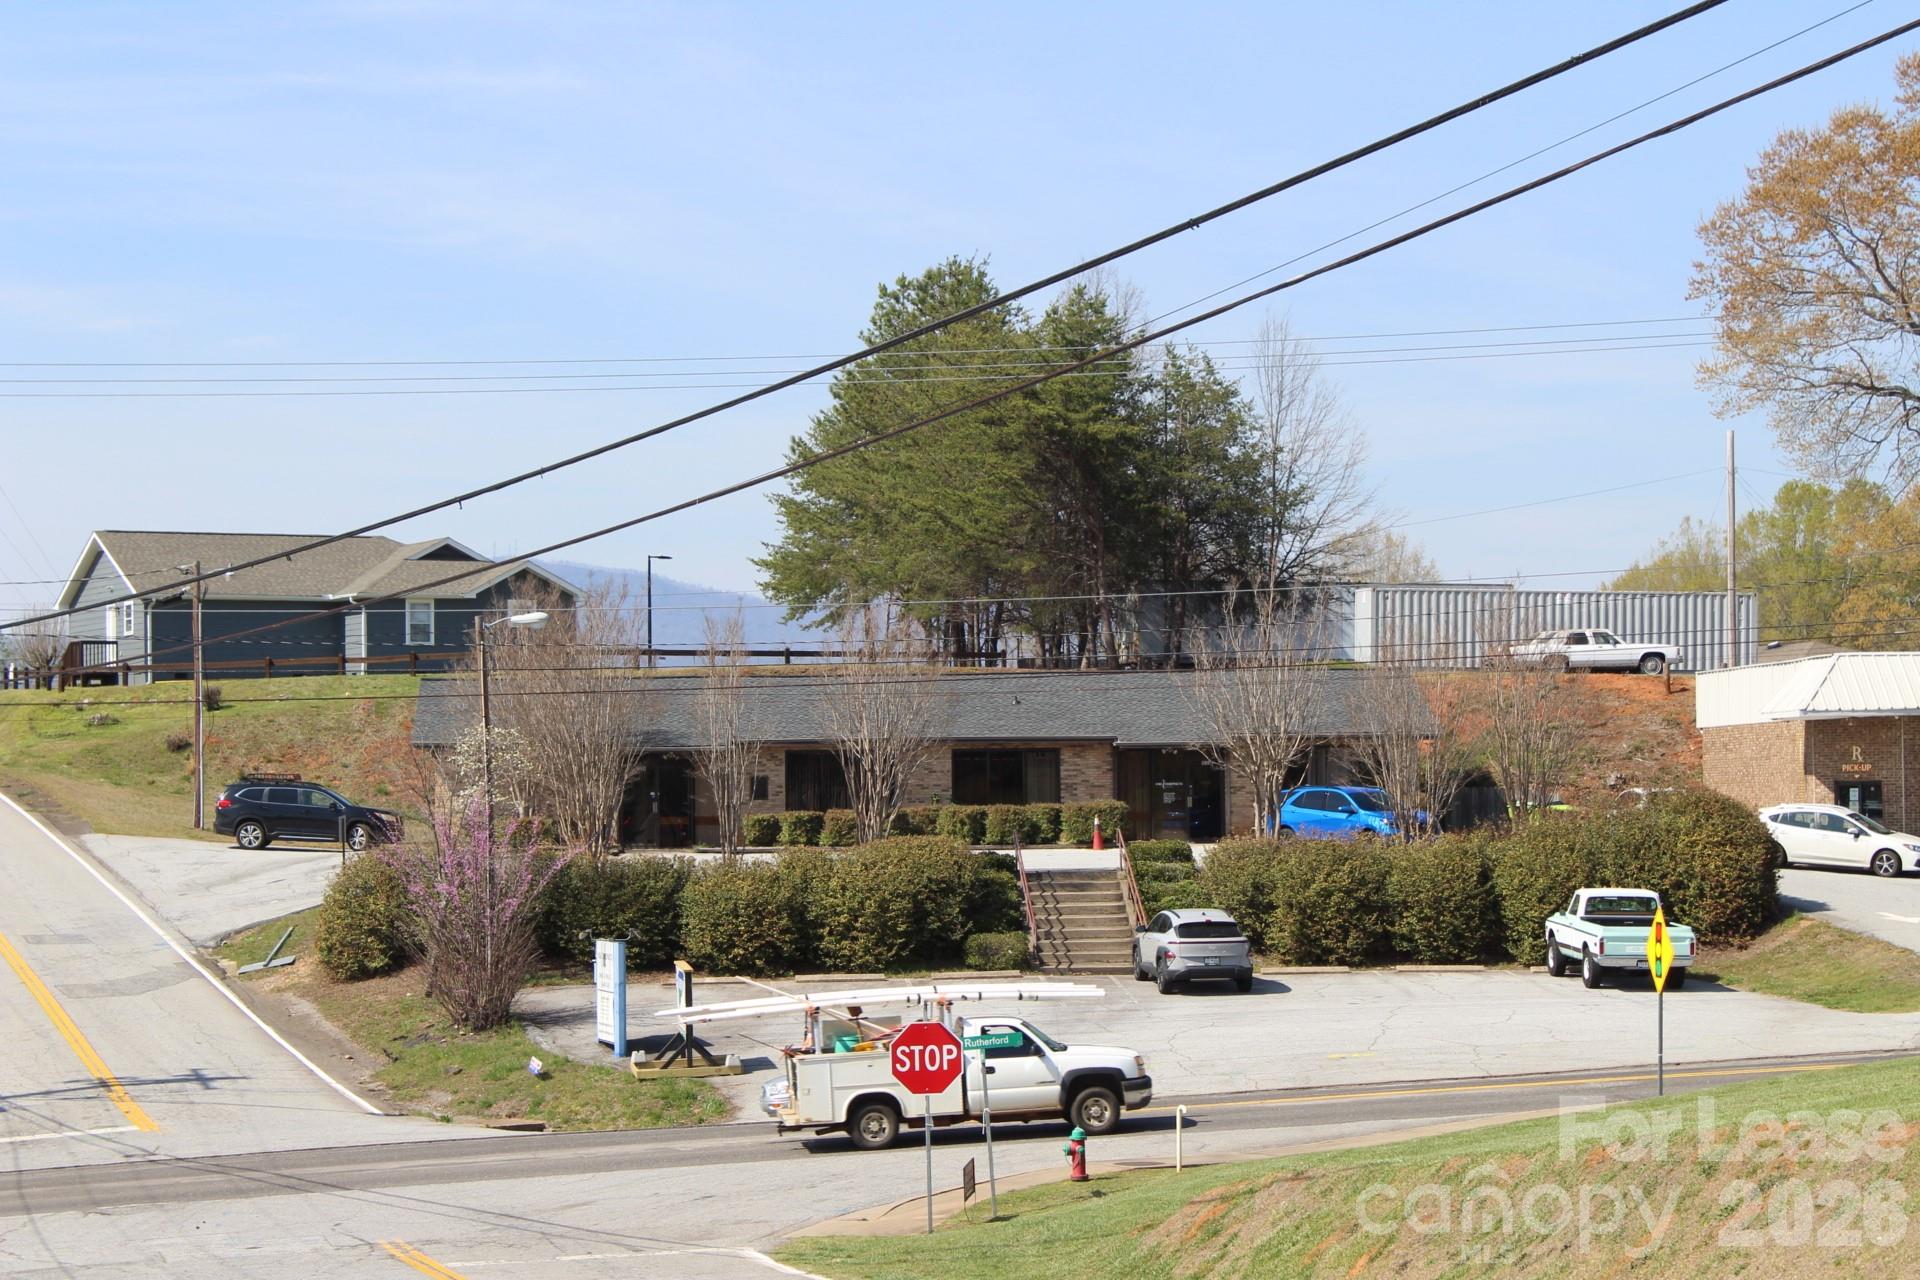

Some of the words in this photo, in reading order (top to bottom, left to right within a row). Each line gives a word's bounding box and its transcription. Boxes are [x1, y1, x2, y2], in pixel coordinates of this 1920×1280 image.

[1842, 764, 1872, 772] PICK-UP
[964, 1035, 1009, 1048] Rutherford
[896, 1045, 957, 1072] STOP
